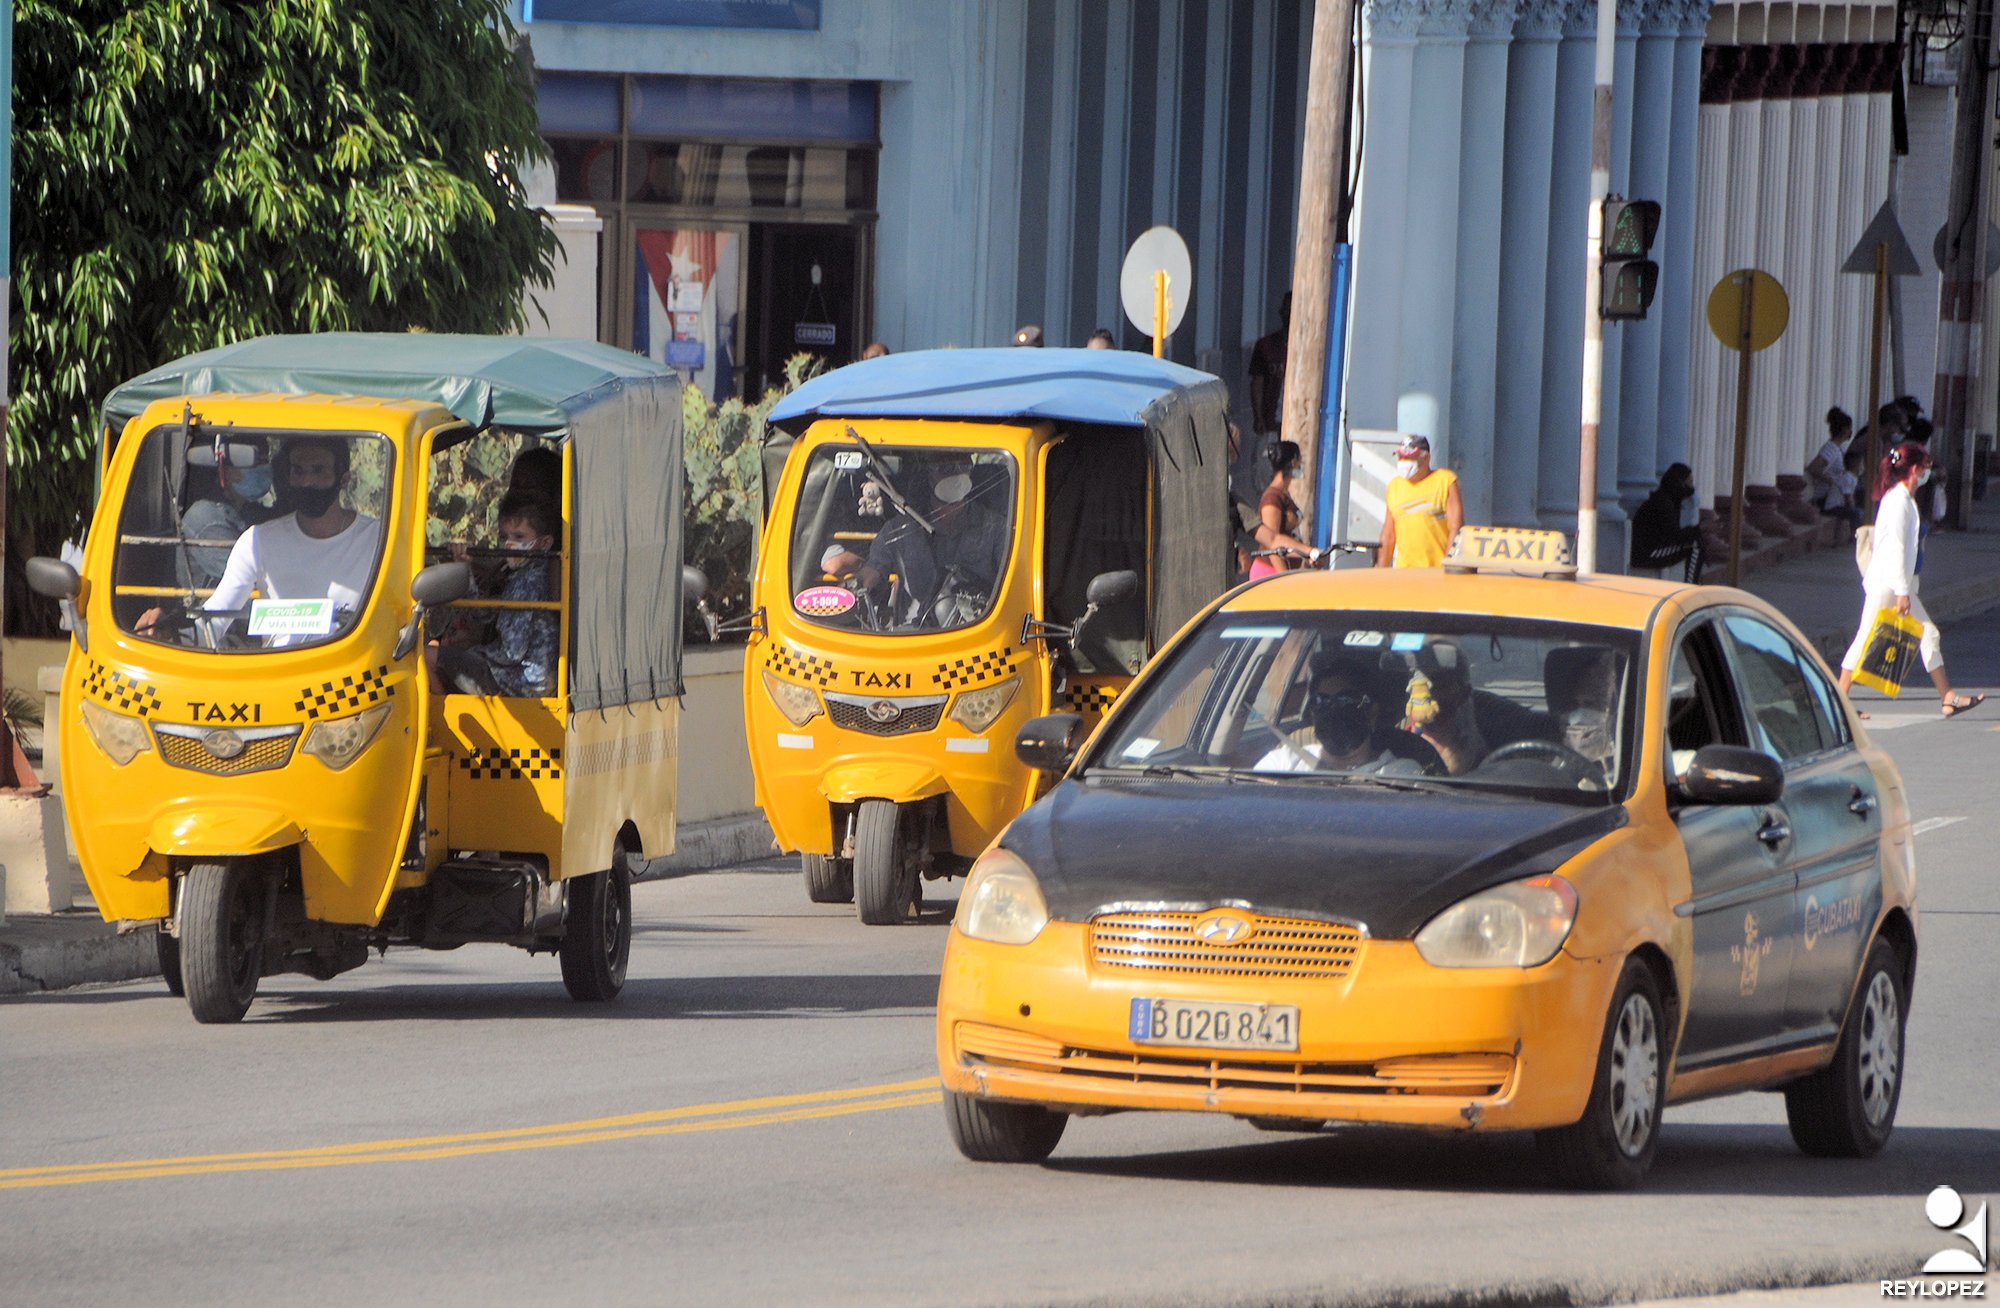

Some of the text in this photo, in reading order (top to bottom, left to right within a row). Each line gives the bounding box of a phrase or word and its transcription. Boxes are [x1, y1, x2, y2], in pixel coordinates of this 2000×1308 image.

[797, 328, 833, 340] CERRADO
[1473, 536, 1547, 561] TAXI
[266, 607, 312, 616] COVID-19
[291, 620, 322, 629] LIBRE
[851, 671, 911, 689] TAXI
[187, 702, 261, 723] TAXI
[1152, 1006, 1291, 1044] B 020 841
